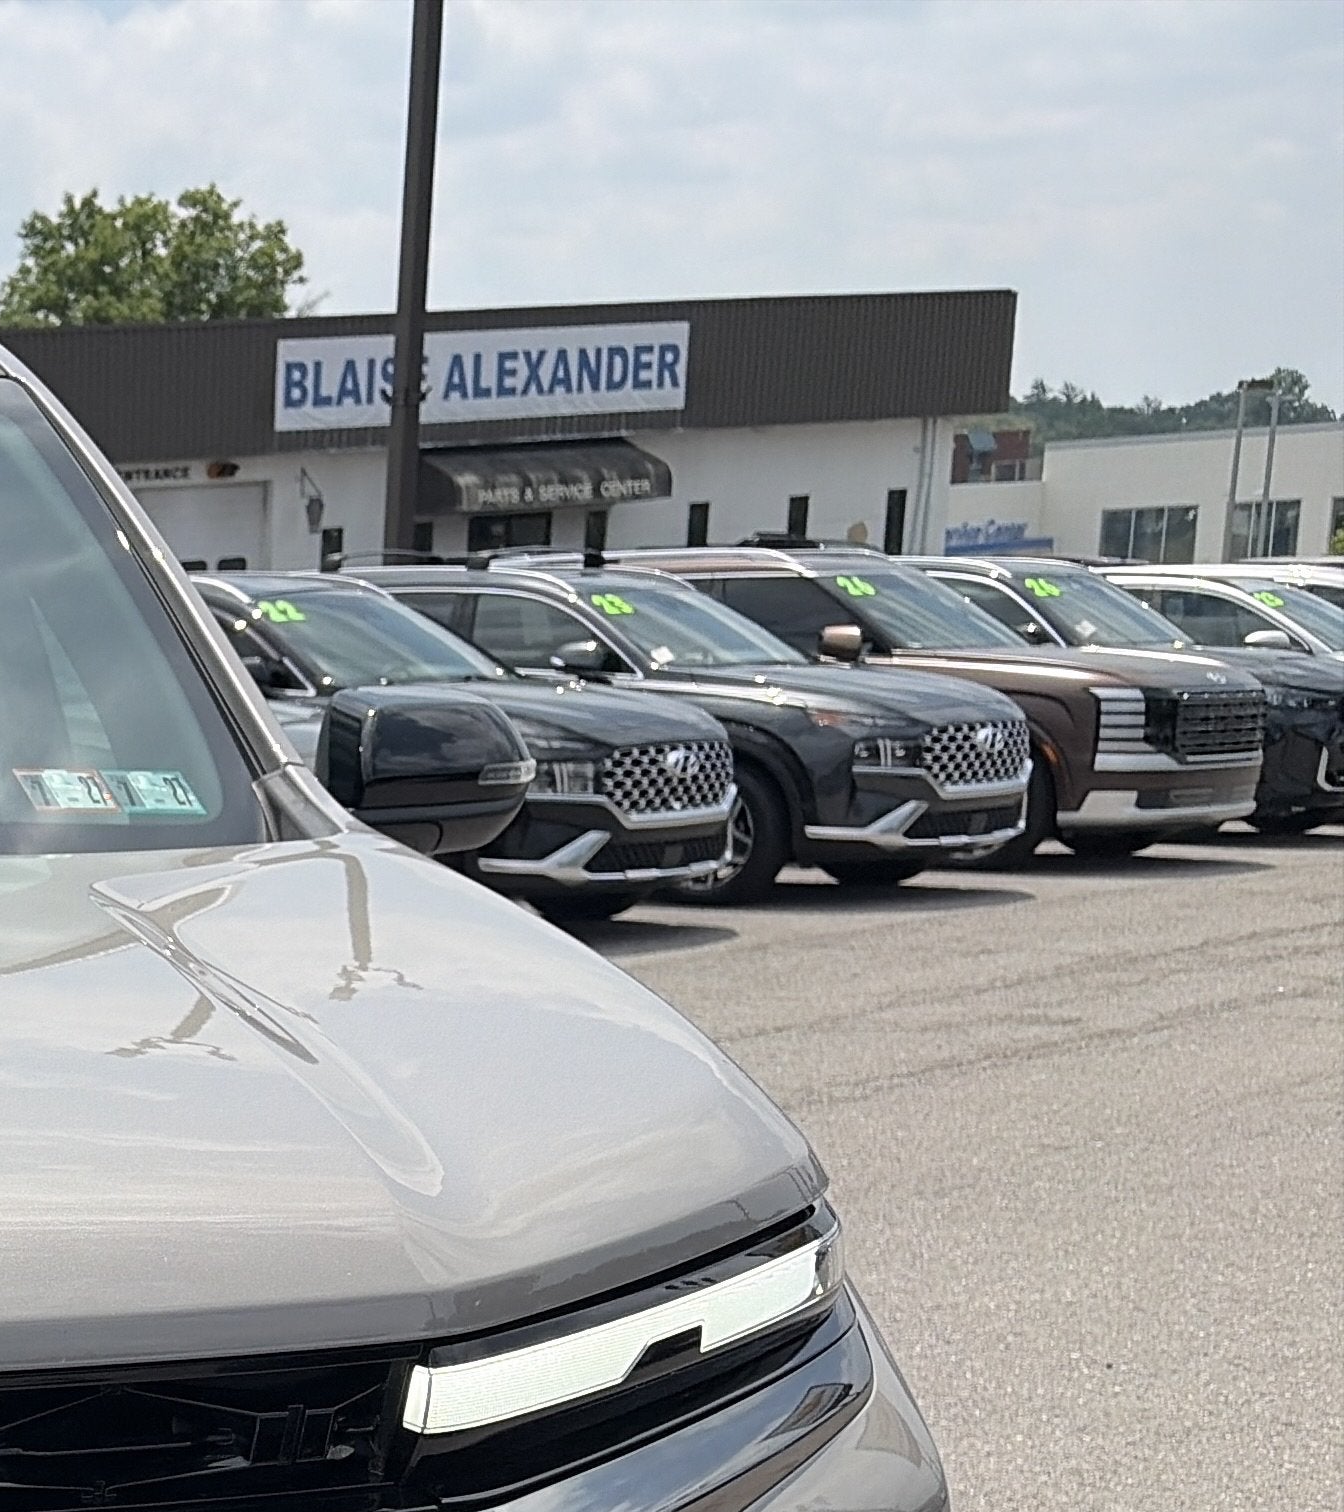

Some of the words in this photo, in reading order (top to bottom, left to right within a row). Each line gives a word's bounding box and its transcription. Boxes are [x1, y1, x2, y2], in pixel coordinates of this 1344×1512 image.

[284, 357, 428, 408] BLAIS
[443, 343, 681, 401] ALEXANDER
[478, 487, 520, 504] PARTS
[524, 486, 534, 502] &
[538, 482, 593, 501] SERVICE
[600, 477, 651, 498] CENTER
[257, 600, 306, 622] 22
[591, 593, 634, 615] 23
